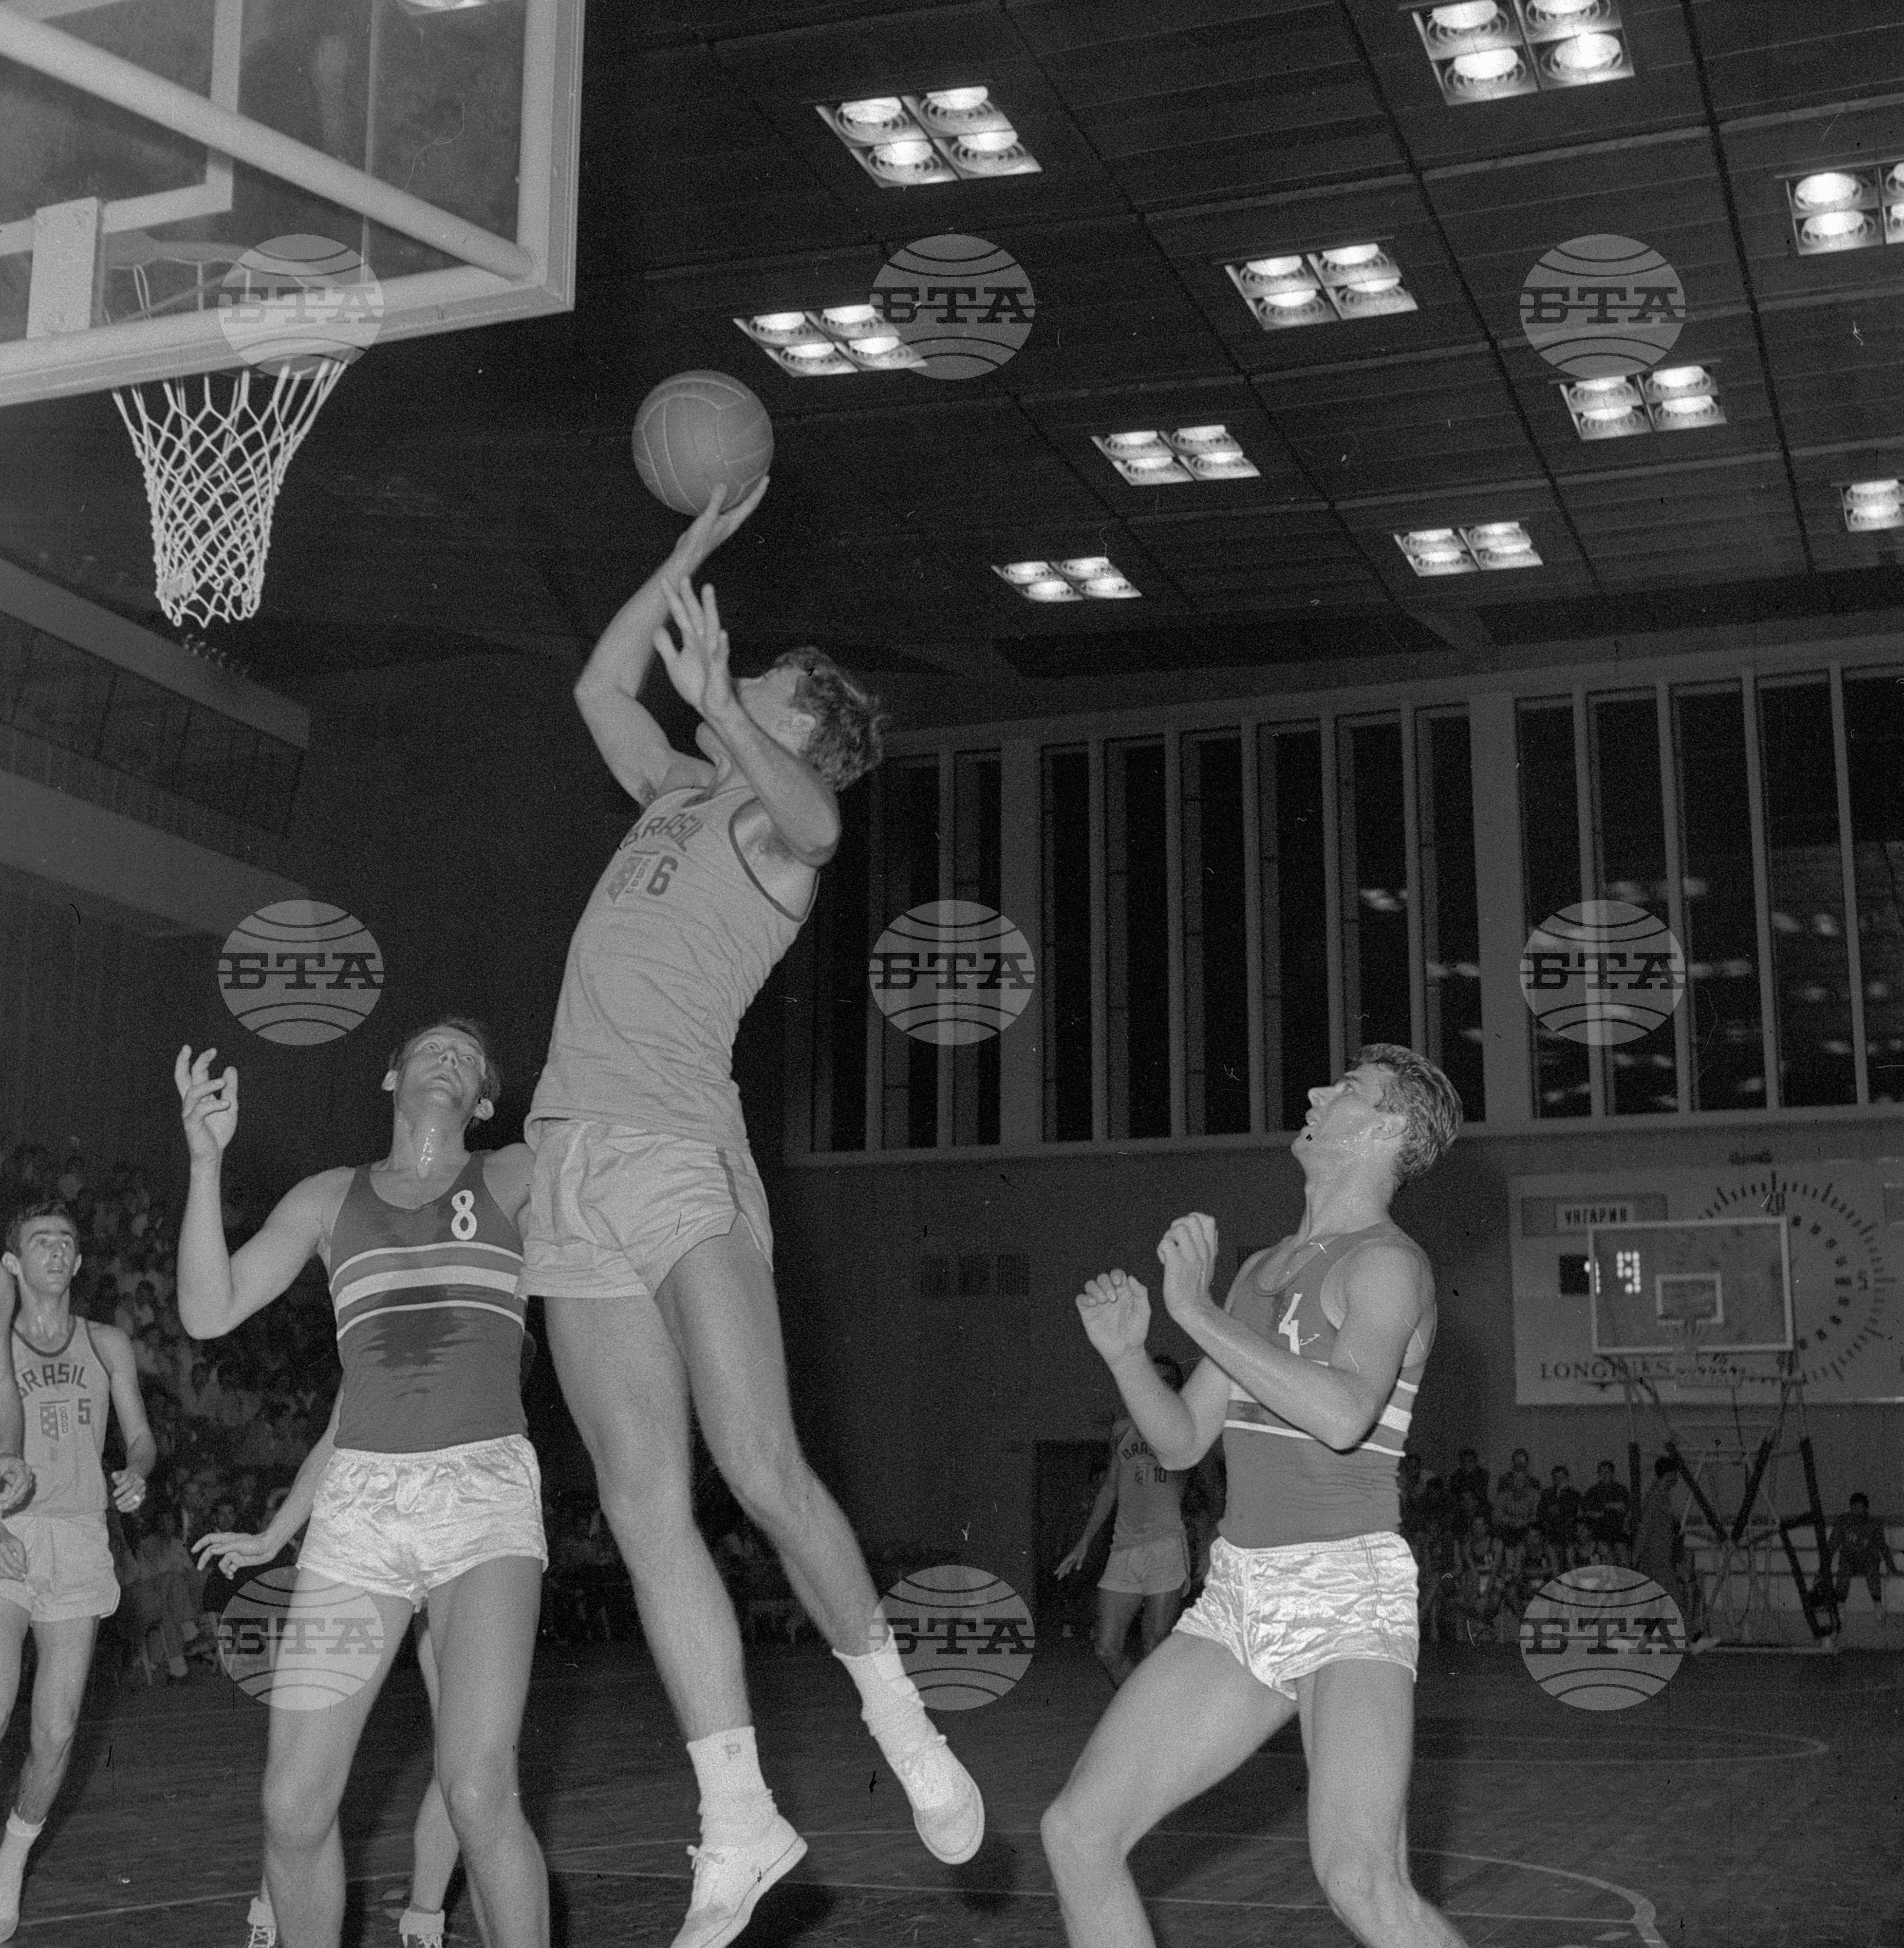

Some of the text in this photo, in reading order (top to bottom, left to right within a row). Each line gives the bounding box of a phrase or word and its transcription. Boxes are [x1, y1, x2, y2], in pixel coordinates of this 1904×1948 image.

[647, 856, 678, 896] 6
[451, 1190, 477, 1240] 8
[1278, 1293, 1303, 1355] 4
[78, 1398, 91, 1425] 5
[1154, 1465, 1167, 1483] 10
